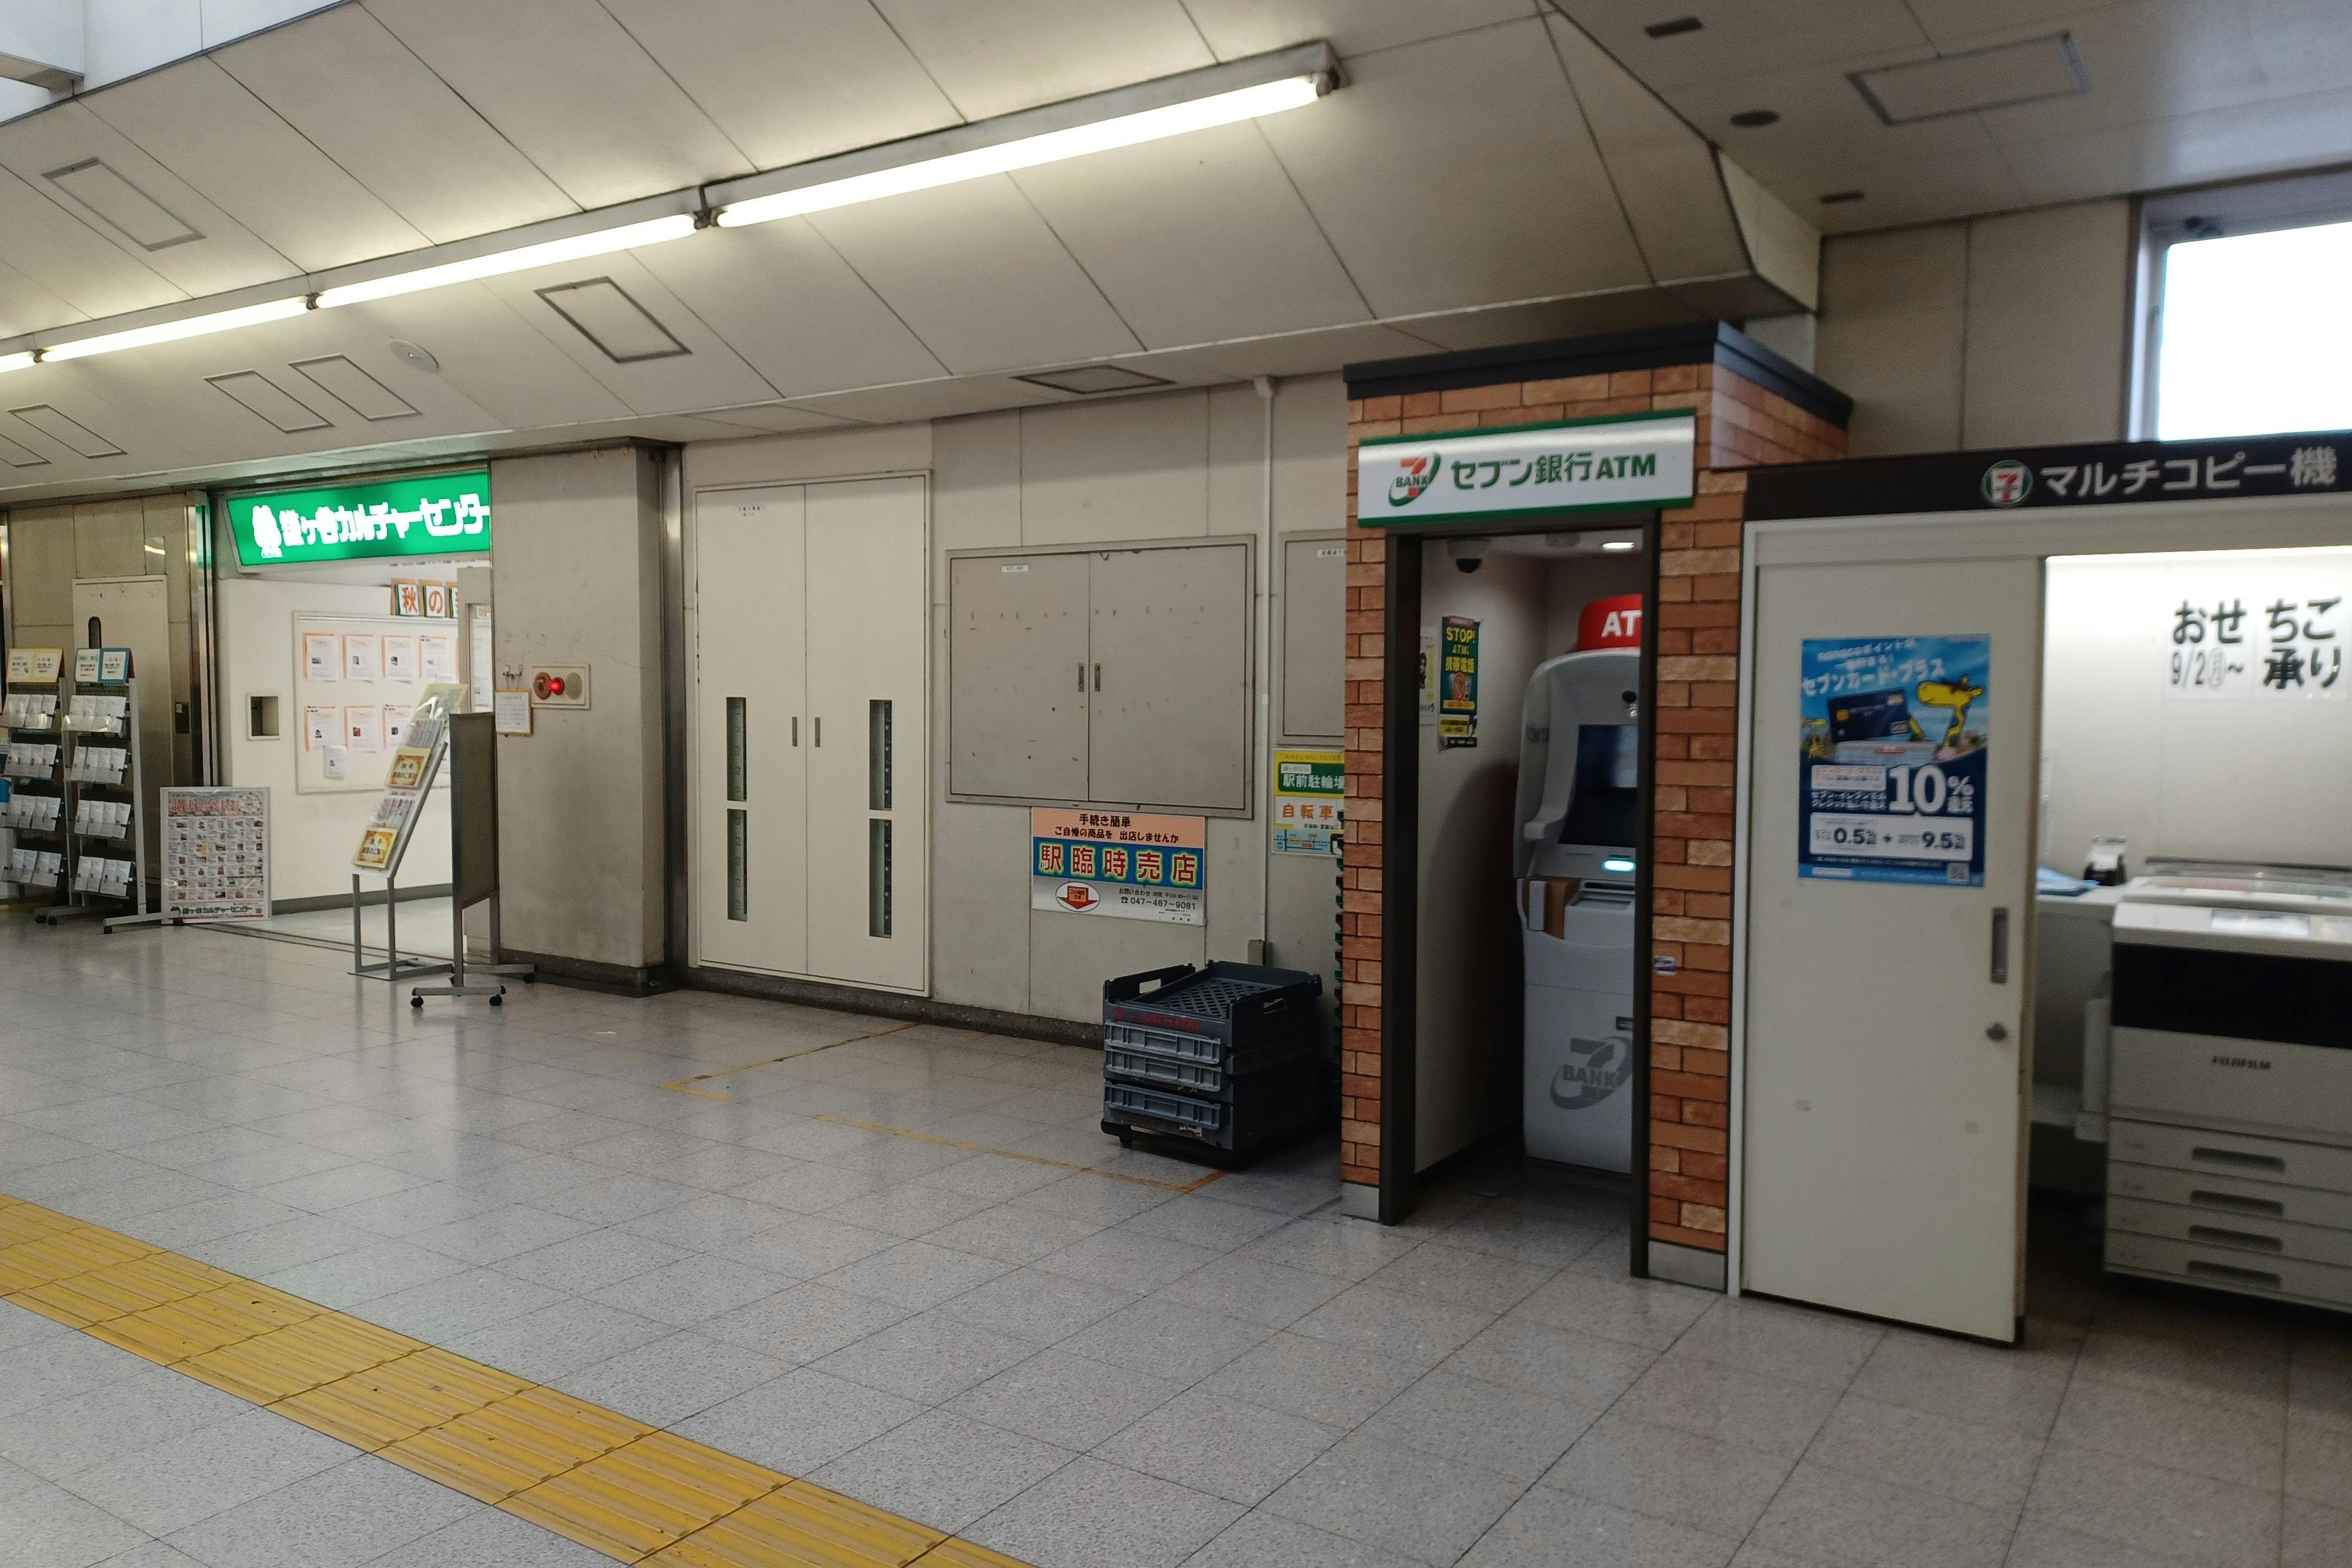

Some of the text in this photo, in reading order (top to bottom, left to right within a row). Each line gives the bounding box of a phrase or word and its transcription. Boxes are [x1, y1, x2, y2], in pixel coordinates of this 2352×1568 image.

[1451, 452, 1656, 490] セブン銀行ATM
[2040, 447, 2337, 498] マルチコピー機
[401, 587, 458, 616] 秋の
[1601, 609, 1642, 638] AT
[1079, 814, 1131, 828] 手続き簡単
[1282, 804, 1333, 820] 自転車
[1055, 826, 1179, 842] ご自慢の商品を 出店しませんか
[1040, 845, 1195, 883] 駅臨時売店
[1119, 888, 1151, 897] お問い合わせ
